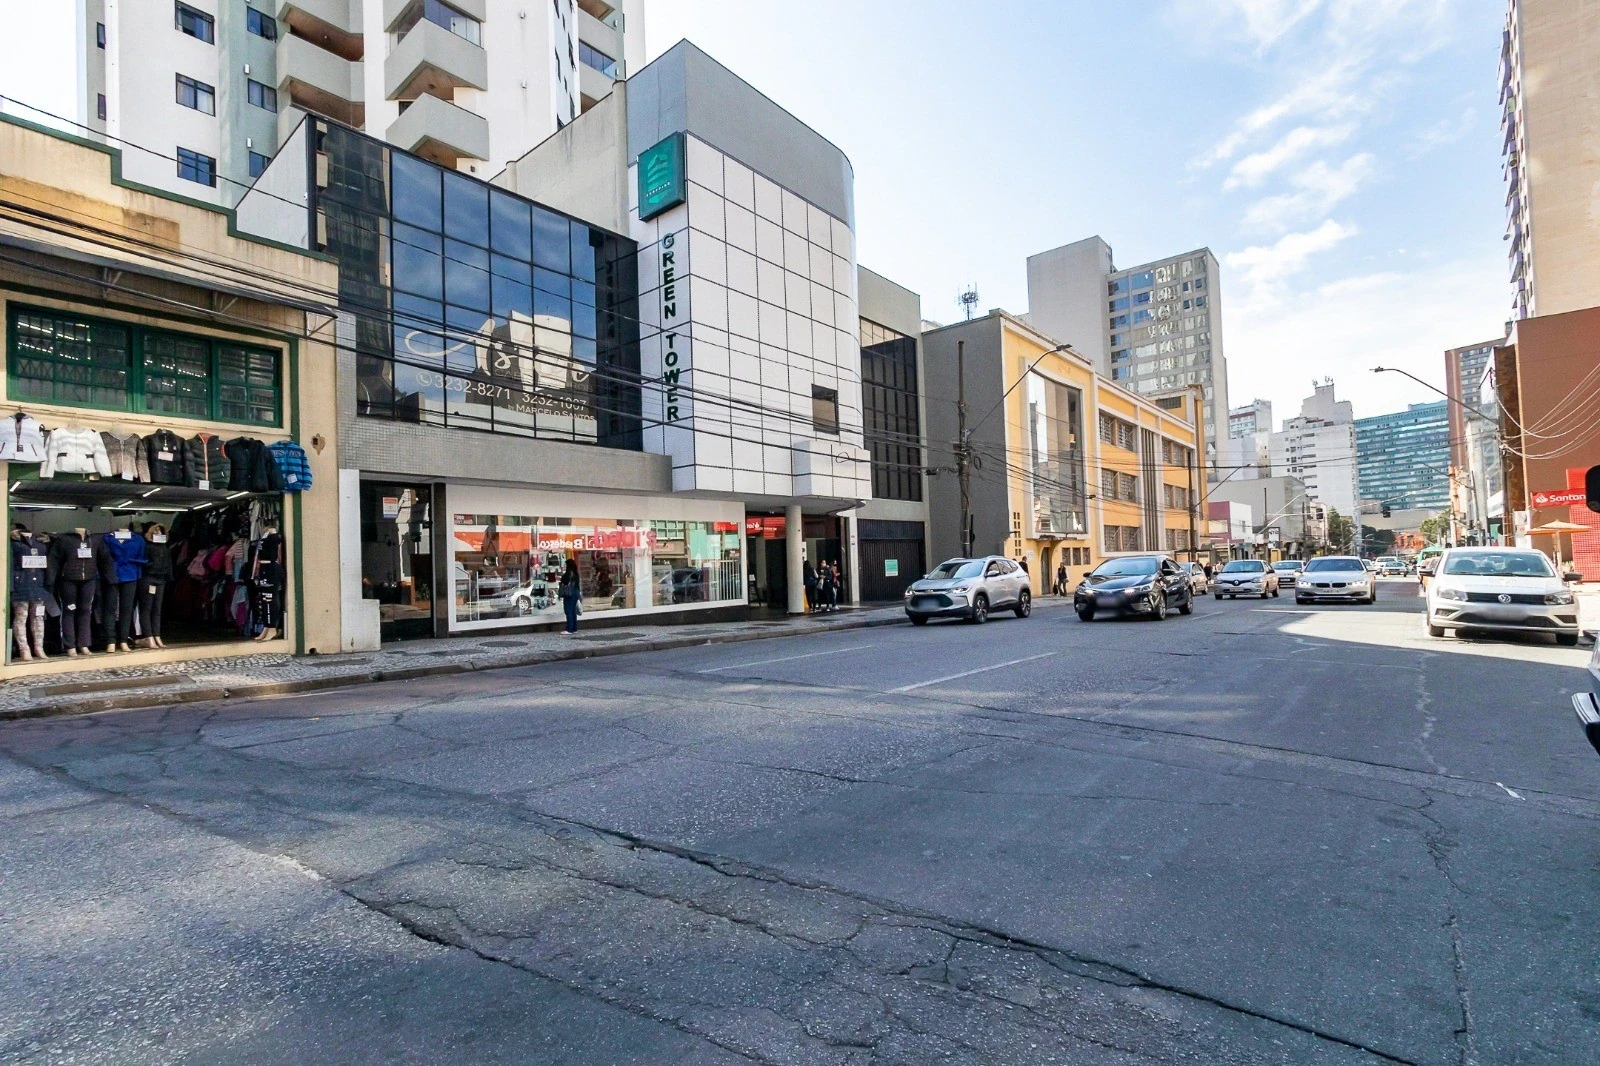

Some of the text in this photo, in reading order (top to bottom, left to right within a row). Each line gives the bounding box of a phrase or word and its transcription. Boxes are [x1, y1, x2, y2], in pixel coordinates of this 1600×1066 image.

[661, 232, 680, 421] GREEN TOWER
[434, 374, 511, 400] 3232-8271
[516, 399, 561, 417] MARCELO
[562, 409, 596, 421] SANTOS
[1549, 493, 1586, 503] Santan
